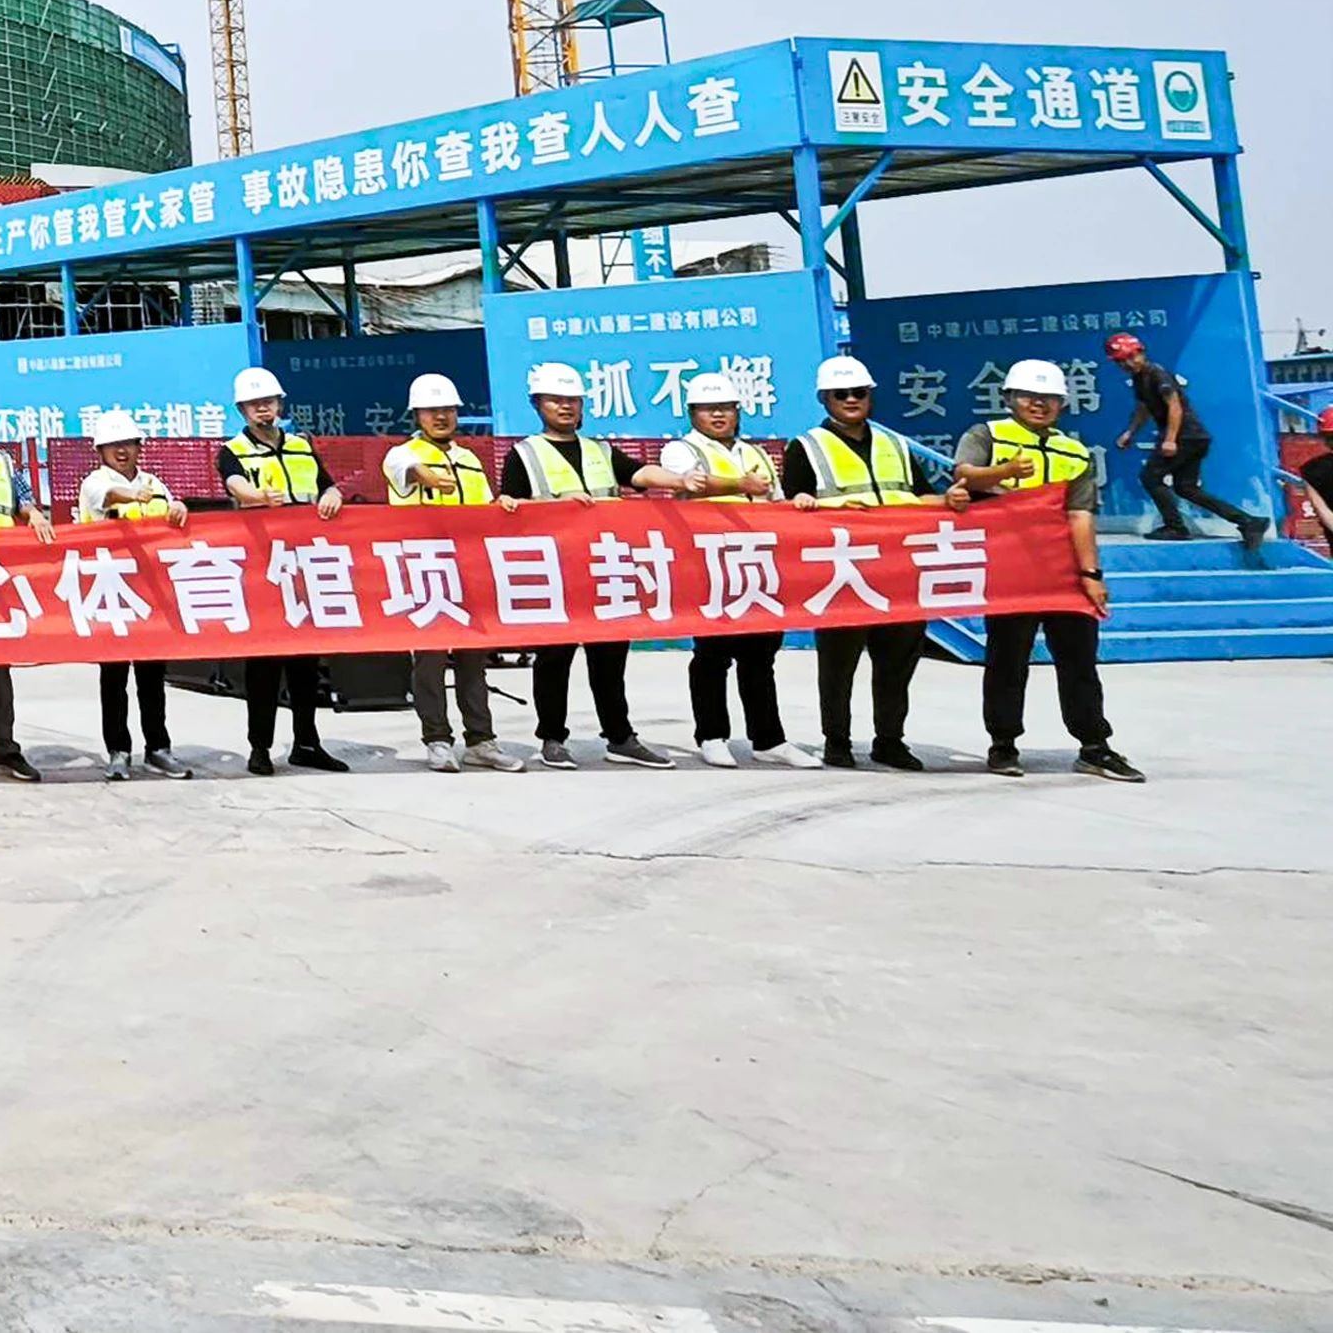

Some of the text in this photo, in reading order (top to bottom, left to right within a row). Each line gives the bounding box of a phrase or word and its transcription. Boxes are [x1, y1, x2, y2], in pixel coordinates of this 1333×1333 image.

[896, 60, 1146, 132] 安全通道
[241, 76, 741, 213] 事故隐患你查我查人人查
[551, 306, 758, 337] 中建八局第二建设有限公司
[926, 309, 1169, 339] 中建八局第二建设有限公司
[528, 356, 778, 419] 抓不懈
